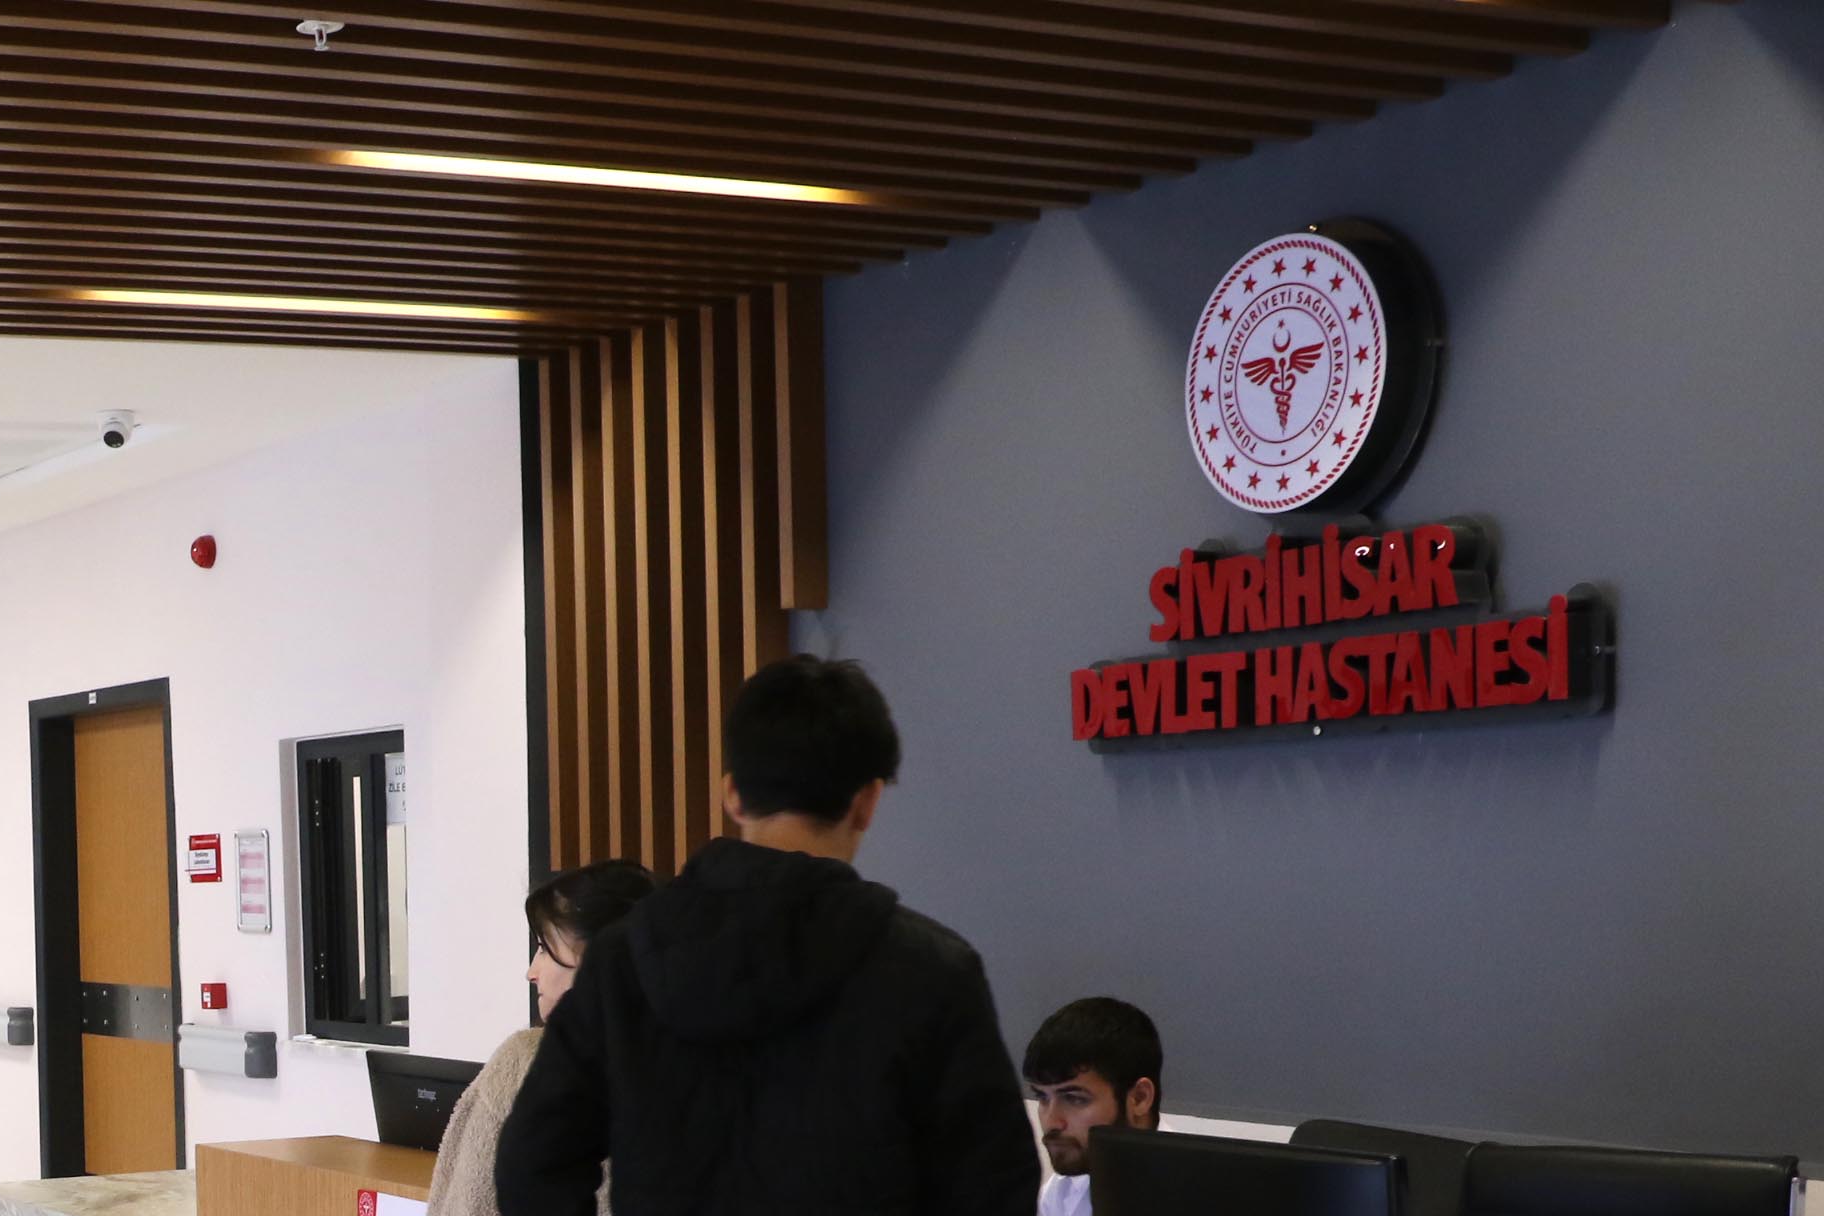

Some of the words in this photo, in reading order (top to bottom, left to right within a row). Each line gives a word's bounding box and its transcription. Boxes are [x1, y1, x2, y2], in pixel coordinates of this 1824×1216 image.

[1224, 288, 1292, 382] CUMHURİYETİ
[1297, 291, 1337, 333] SAĞLIK
[1224, 391, 1258, 453] TÜRKİYE
[1311, 336, 1344, 437] BAKANLIĞI
[1149, 523, 1460, 642] SİVRİHİSAR
[1070, 651, 1247, 741] DEVLET
[1254, 594, 1569, 727] HASTANESİ
